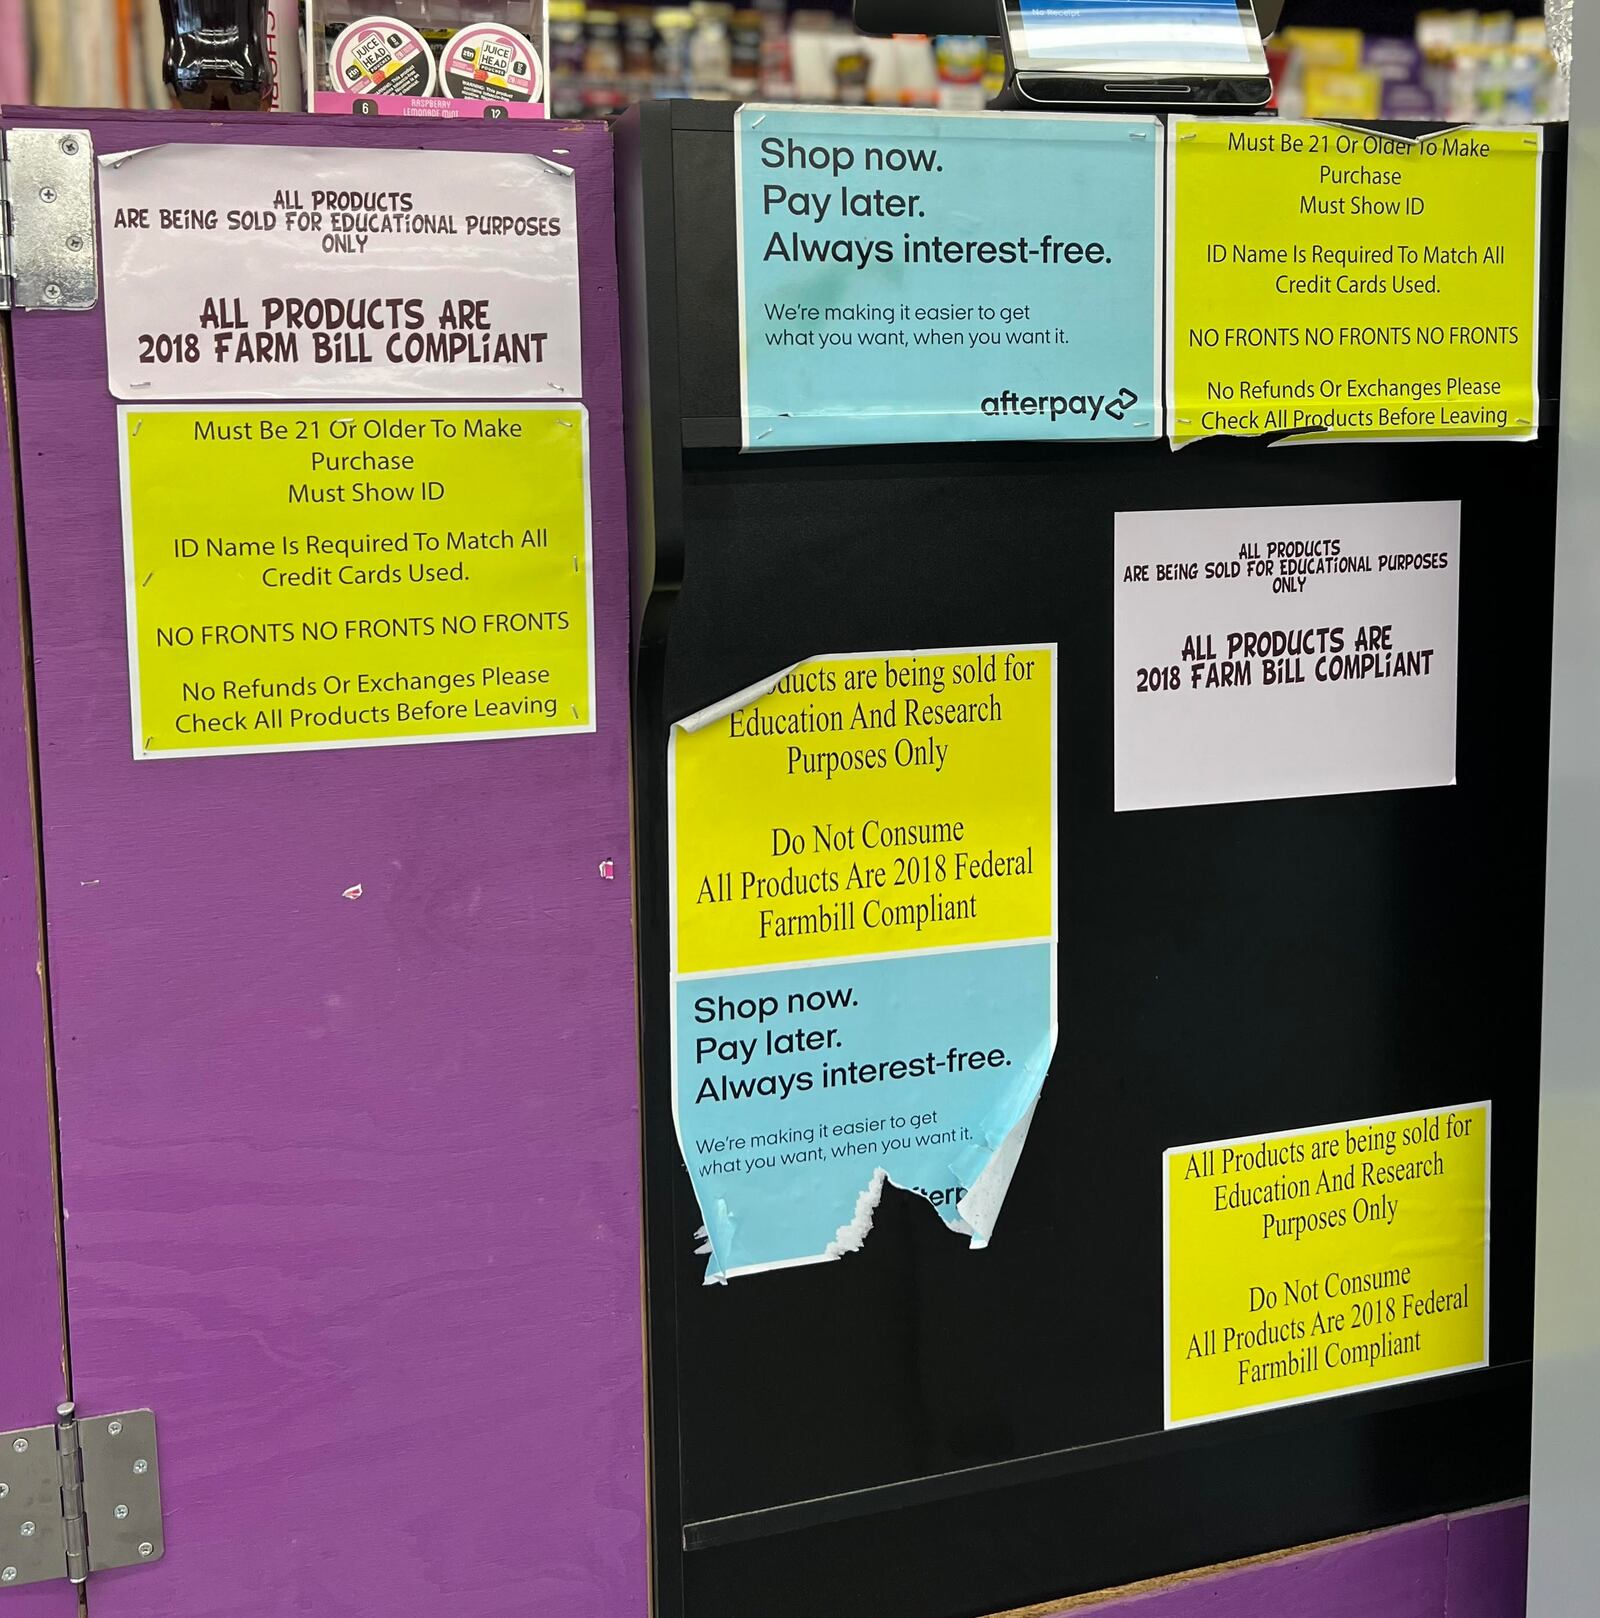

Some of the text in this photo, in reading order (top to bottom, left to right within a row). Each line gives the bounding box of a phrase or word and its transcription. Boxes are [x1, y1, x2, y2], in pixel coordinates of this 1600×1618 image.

[1048, 9, 1080, 18] Receipt
[356, 38, 379, 58] JUICE
[362, 48, 386, 68] HEAD
[481, 55, 507, 68] HEAD
[484, 45, 509, 58] JUICE
[481, 65, 504, 76] POUCHES
[362, 102, 369, 115] 6
[403, 108, 441, 117] LEMONADE
[411, 98, 450, 108] RASPBERRY
[490, 109, 501, 119] 12
[761, 137, 943, 177] Shop now.
[1320, 166, 1401, 185] Purchase
[273, 190, 413, 212] ALL PRODUCTS
[763, 185, 926, 223] Pay later.
[1300, 196, 1424, 215] Must Show ID
[114, 208, 150, 229] ARE
[227, 210, 276, 231] SOLD
[285, 212, 322, 231] FOR
[465, 215, 561, 236] PURPOSES
[322, 234, 368, 253] ONLY
[763, 232, 1112, 270] Always interest-free.
[1276, 275, 1441, 294] Credit Cards Used.
[199, 297, 491, 330] ALL PRODUCTS ARE
[764, 304, 1030, 324] We're making it easier to get
[138, 333, 200, 363] 2018
[214, 332, 298, 364] FARM
[765, 328, 1069, 349] what you want, when you want it.
[1208, 377, 1501, 400] No Refunds Or Exchanges Please
[981, 390, 1104, 421] afterpay
[193, 418, 522, 440] Must Be 21 Or Older To Make
[311, 451, 415, 470] Purchase
[288, 482, 444, 503] Must Show ID
[174, 529, 548, 559] ID Name Is Required To Match All
[1239, 539, 1340, 559] ALL PRODUCTS
[262, 562, 470, 587] Credit Cards Used.
[1272, 576, 1306, 594] ONLY
[156, 611, 570, 647] NO FRONTS NO FRONTS NO FRONTS
[1181, 625, 1393, 661] ALL PRODUCTS ARE
[175, 696, 558, 733] Check All Products Before Leaving
[729, 693, 1002, 737] Education And Research
[787, 736, 948, 781] Purposes Only
[772, 819, 964, 857] Do Not Consume
[697, 847, 1033, 904] All Products Are 2018 Federal
[759, 893, 976, 939] Farmbill Compliant
[694, 987, 858, 1023] Shop now.
[695, 1028, 842, 1065] Pay later.
[695, 1047, 1012, 1104] Always interest-free.
[699, 1127, 973, 1177] what you want, when you want it.
[1184, 1113, 1472, 1180] All Products are being sold for
[1214, 1151, 1444, 1211] Education And Research
[1263, 1194, 1398, 1241] Purposes Only
[1249, 1266, 1411, 1312] Do Not Consume
[1238, 1330, 1421, 1385] Farmbill Compliant
